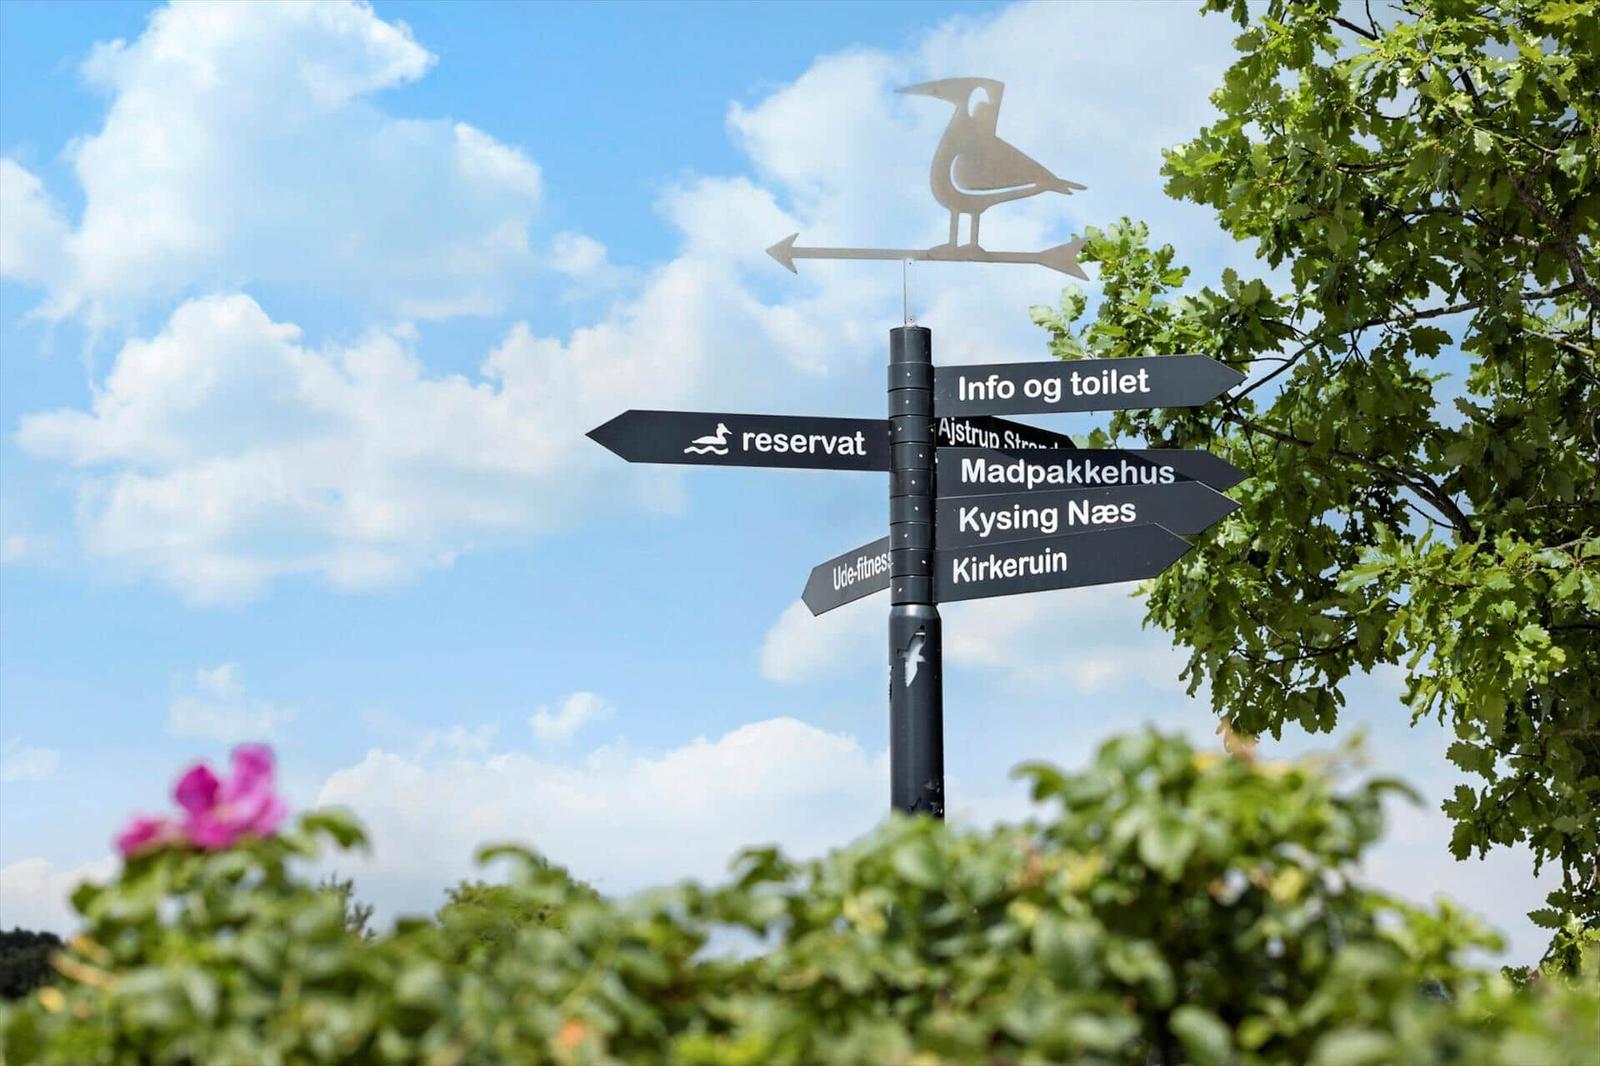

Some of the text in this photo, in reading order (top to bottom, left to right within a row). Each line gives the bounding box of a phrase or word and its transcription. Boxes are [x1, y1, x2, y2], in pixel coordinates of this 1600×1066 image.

[958, 368, 1150, 404] Info og toilet
[742, 430, 866, 455] reservat
[961, 458, 1175, 489] Madpakkehus
[958, 499, 1137, 537] Kysing Næs
[952, 547, 1067, 583] Kirkeruin
